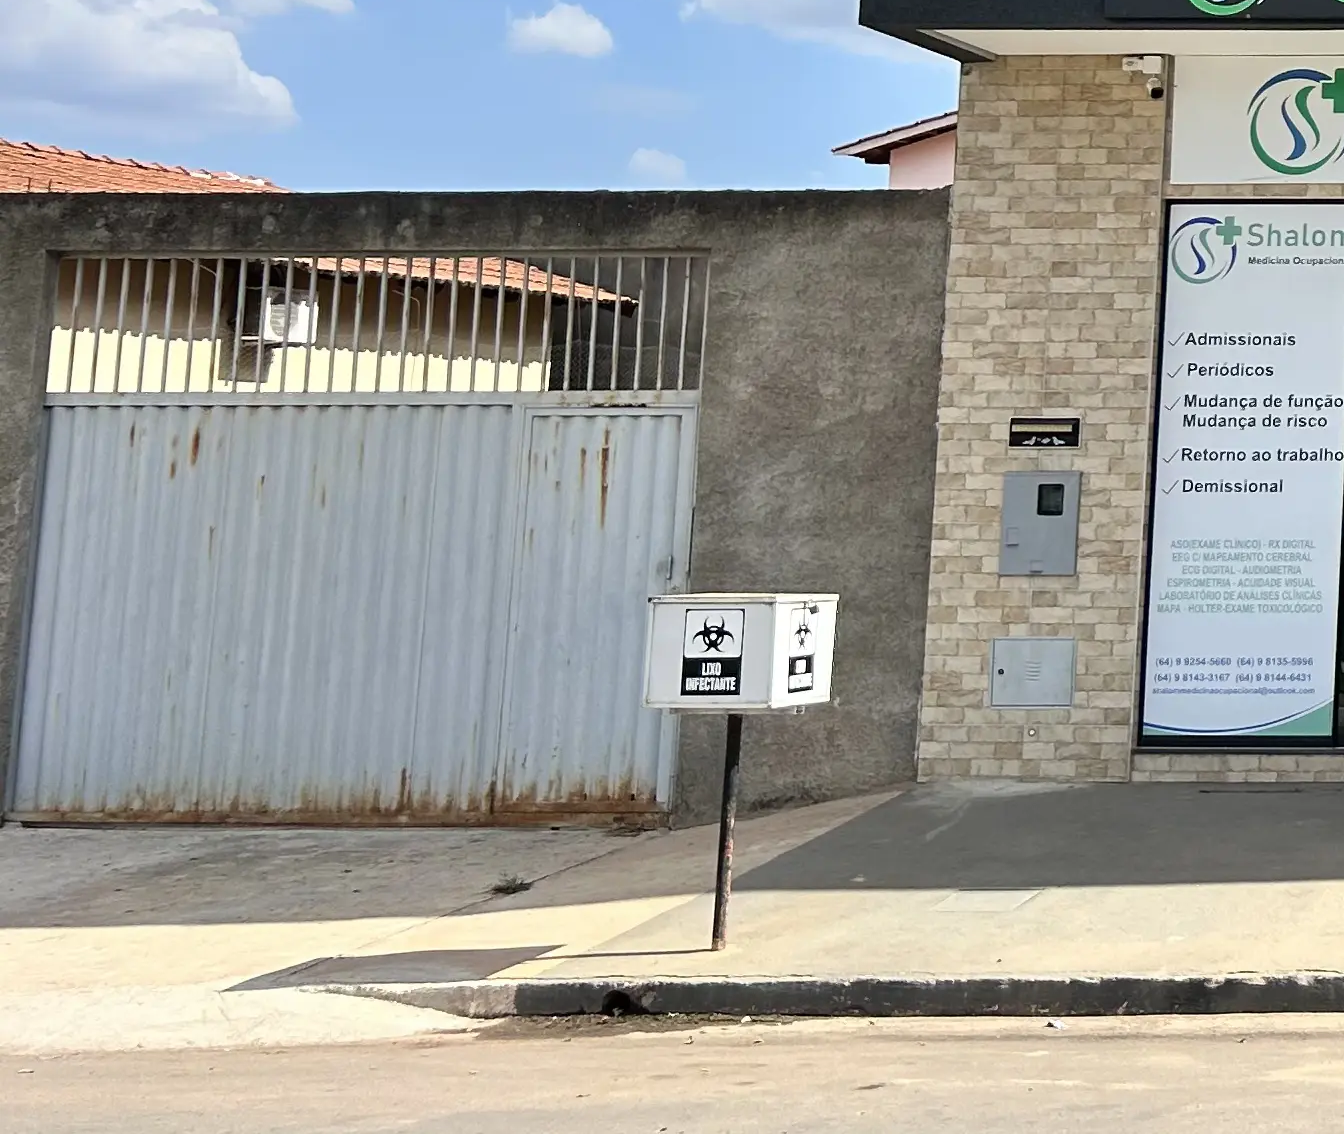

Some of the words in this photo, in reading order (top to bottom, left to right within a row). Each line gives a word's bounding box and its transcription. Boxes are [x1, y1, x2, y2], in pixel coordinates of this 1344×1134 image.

[1248, 256, 1291, 265] Medicina
[1184, 332, 1297, 346] Admissionais
[1187, 362, 1274, 377] Periódicos
[1183, 394, 1258, 410] Mudança
[1263, 394, 1282, 408] de
[1287, 394, 1344, 410] função
[1182, 414, 1256, 430] Mudança
[1262, 414, 1281, 427] de
[1286, 414, 1328, 427] risco
[1181, 448, 1246, 462] Retorno
[1251, 451, 1272, 462] ao
[1277, 448, 1344, 462] trabalho
[1182, 479, 1284, 493] Demissional
[702, 662, 722, 676] LIXO
[685, 676, 737, 691] INFECTANTE
